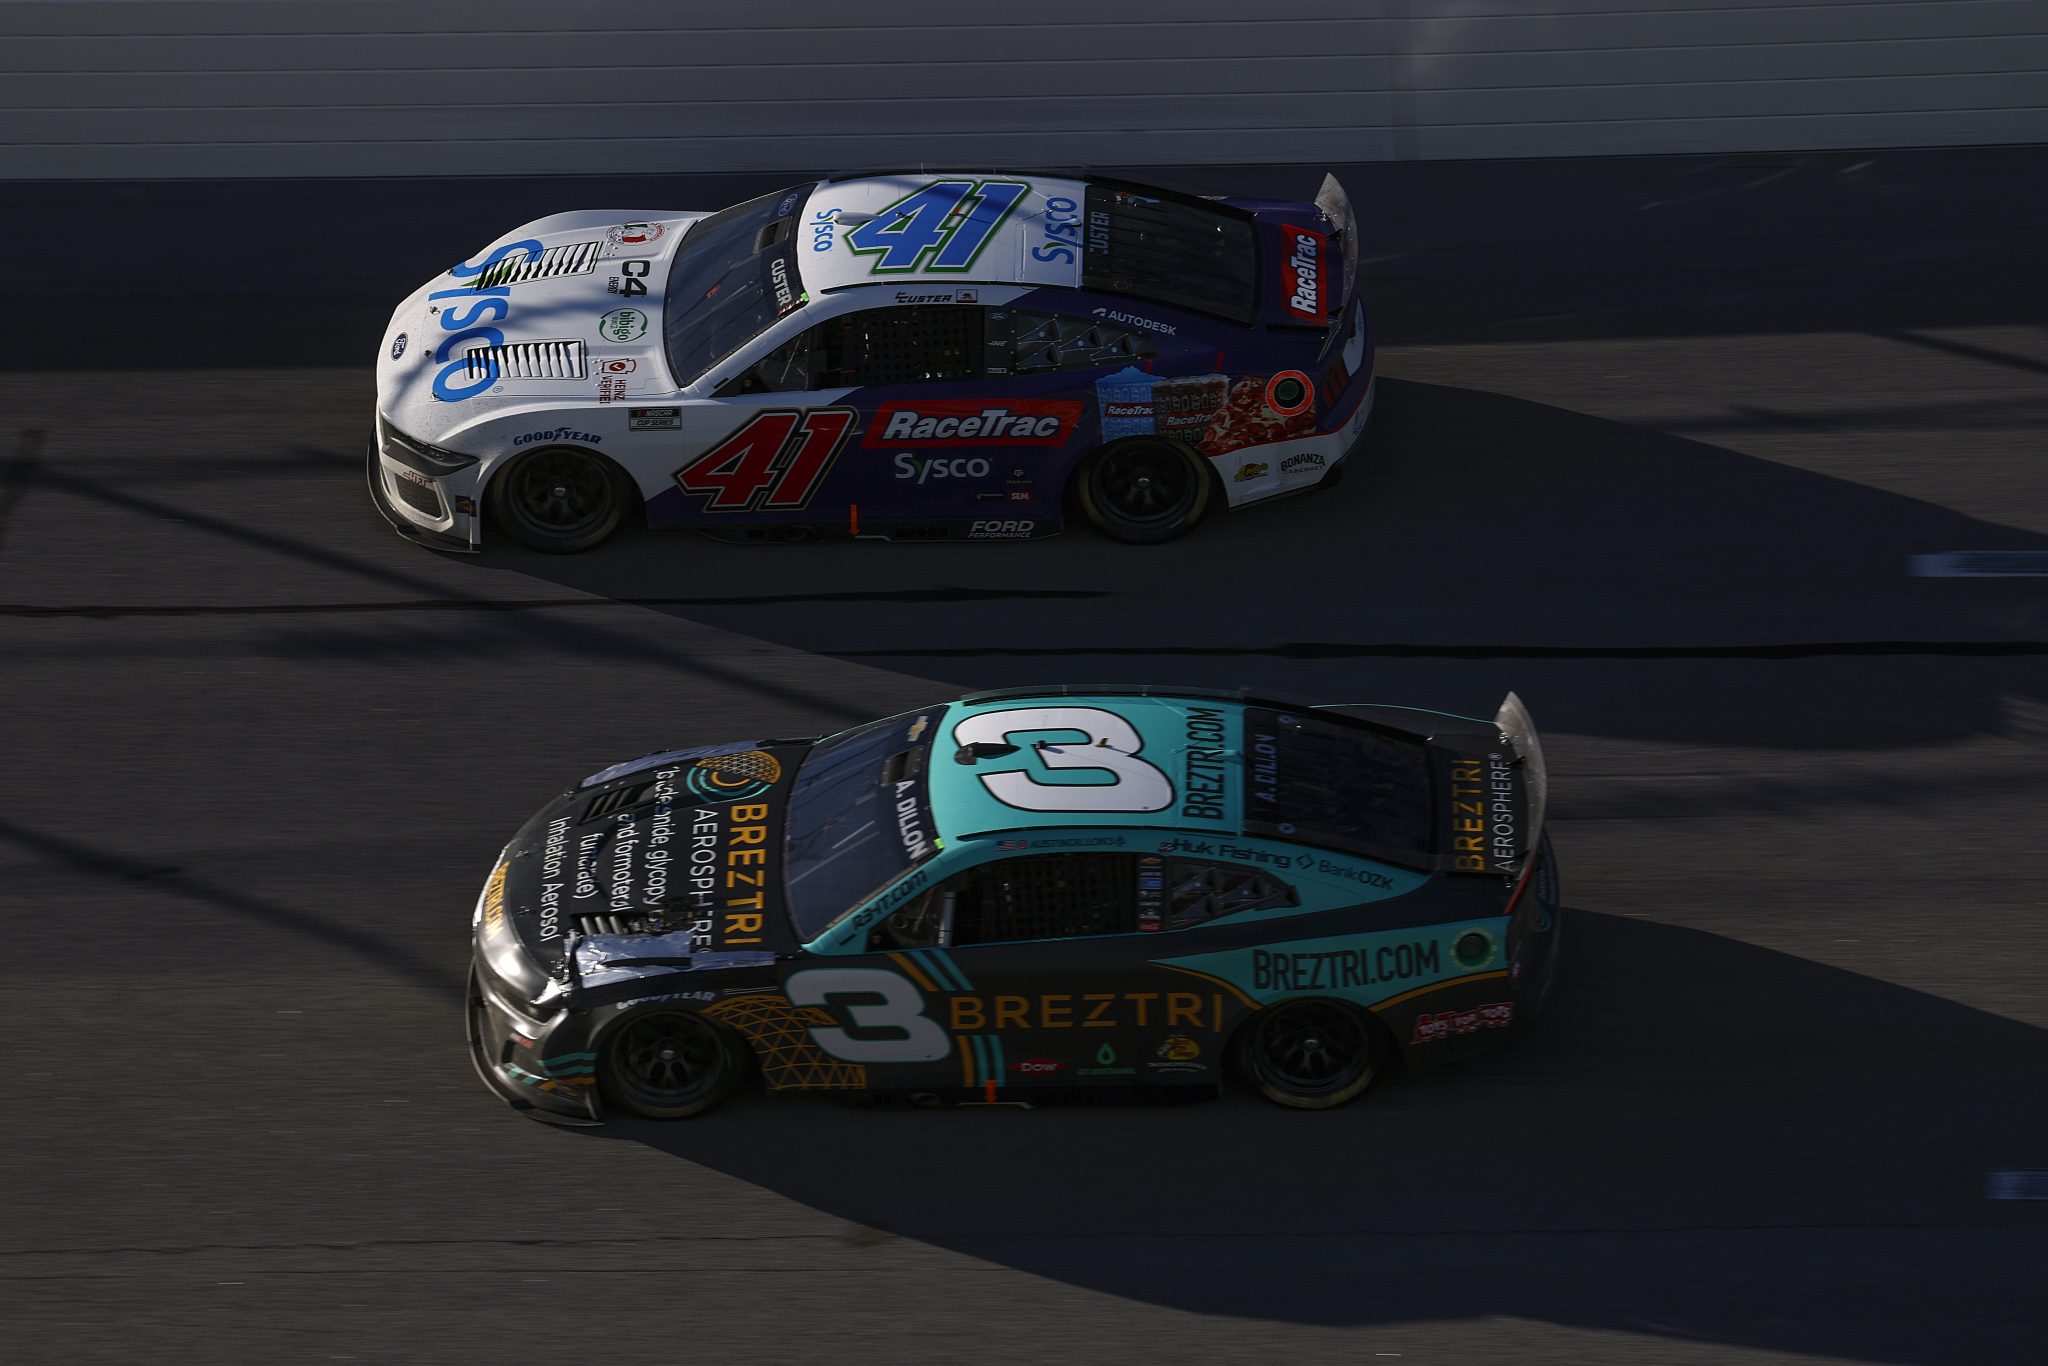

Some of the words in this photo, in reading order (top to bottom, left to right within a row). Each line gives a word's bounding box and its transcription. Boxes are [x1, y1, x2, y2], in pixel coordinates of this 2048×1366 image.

[810, 208, 842, 253] Sysco
[843, 179, 1032, 275] 41
[1032, 197, 1085, 265] Sysco
[608, 277, 619, 295] ENERGY
[621, 260, 650, 298] C4
[770, 258, 793, 307] CUSTER
[1290, 234, 1317, 315] RaceTrac
[895, 290, 953, 304] CUSTER
[612, 310, 635, 341] bibigo
[1107, 309, 1177, 336] AUTODESK
[614, 379, 626, 400] HEINZ
[513, 427, 602, 446] GOODYEAR
[882, 408, 1062, 441] RaceTrac
[1167, 413, 1213, 426] RaceTra
[672, 406, 860, 513] 41
[894, 453, 989, 484] Sysco
[1280, 453, 1326, 472] BONANZA
[967, 531, 1033, 539] PERFORMANCE
[969, 520, 1035, 533] FORD
[953, 706, 1174, 813] 3
[1182, 707, 1225, 821] BREZTRI.COM
[616, 813, 640, 839] and
[896, 799, 930, 860] DILLON
[1451, 758, 1486, 873] BREZTRI
[542, 816, 572, 880] Inhalation
[1218, 844, 1291, 869] Fishing
[610, 839, 640, 912] formoterol
[723, 803, 767, 945] BREZTRI
[540, 882, 564, 942] Aerosol
[1253, 940, 1441, 991] BREZTRI.COM
[786, 968, 951, 1064] 3
[951, 993, 1224, 1033] BREZTRI
